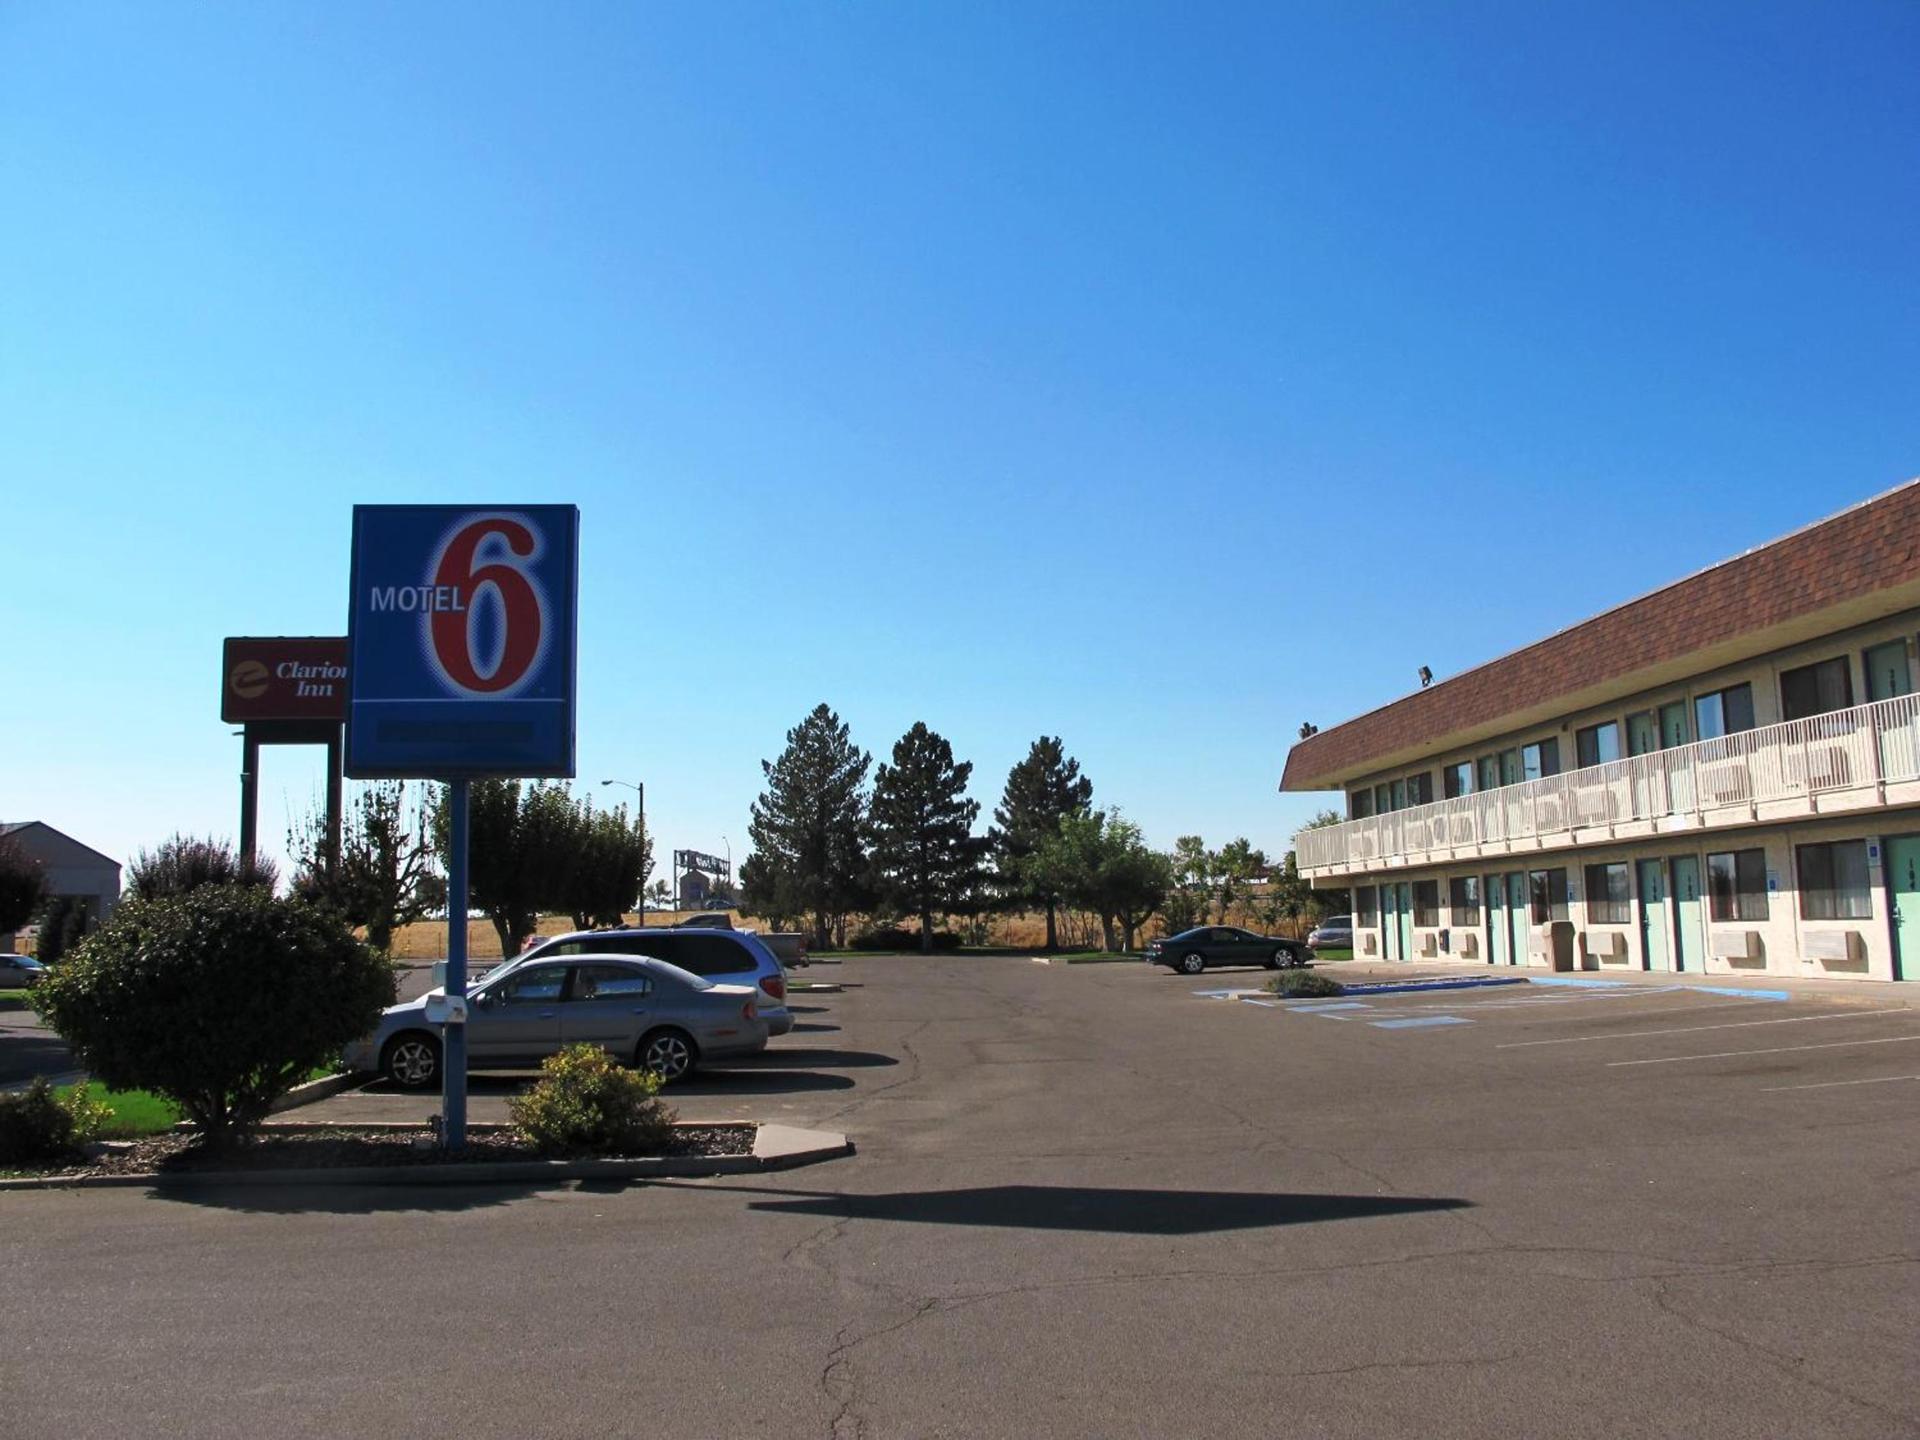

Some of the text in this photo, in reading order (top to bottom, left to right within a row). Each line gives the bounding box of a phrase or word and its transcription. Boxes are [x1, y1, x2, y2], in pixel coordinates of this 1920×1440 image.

[371, 516, 543, 694] MOTEL 6
[295, 681, 333, 697] Inn
